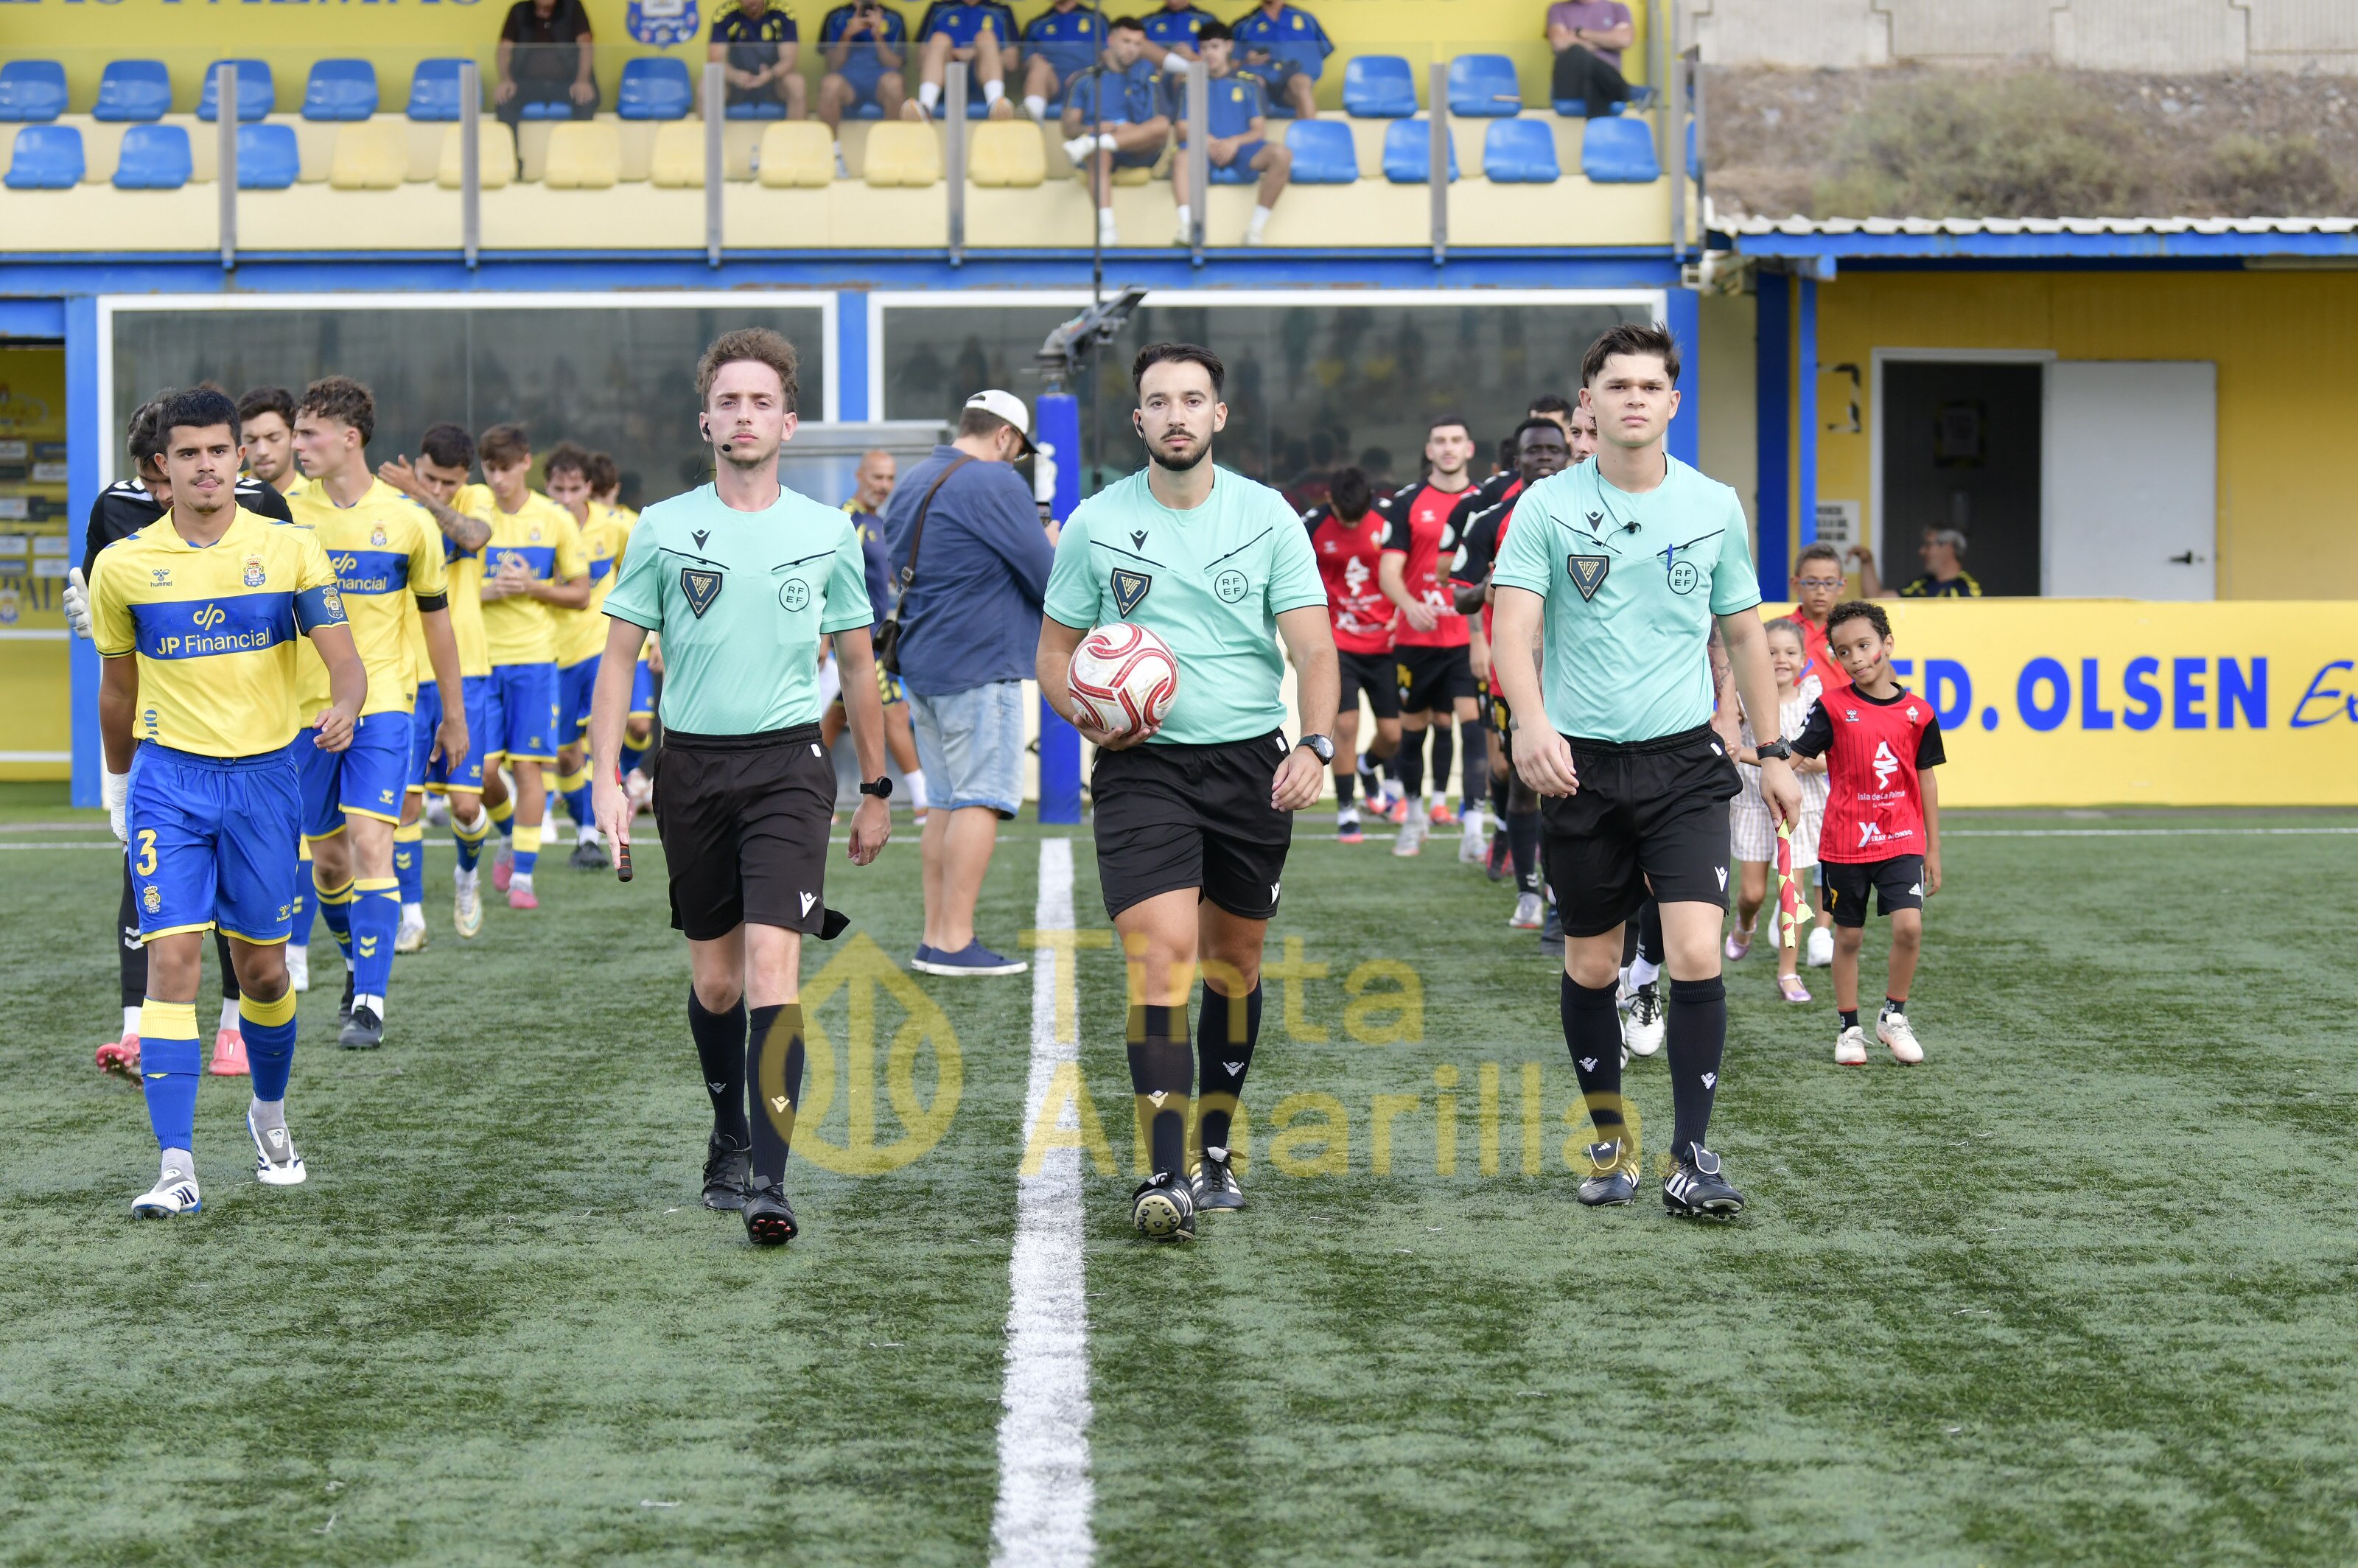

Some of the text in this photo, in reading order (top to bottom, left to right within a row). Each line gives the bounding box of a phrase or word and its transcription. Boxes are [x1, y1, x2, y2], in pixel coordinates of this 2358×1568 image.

[337, 576, 388, 591] nancial
[156, 627, 270, 655] JP Financial
[1858, 792, 1871, 801] Isla
[136, 829, 158, 877] 3
